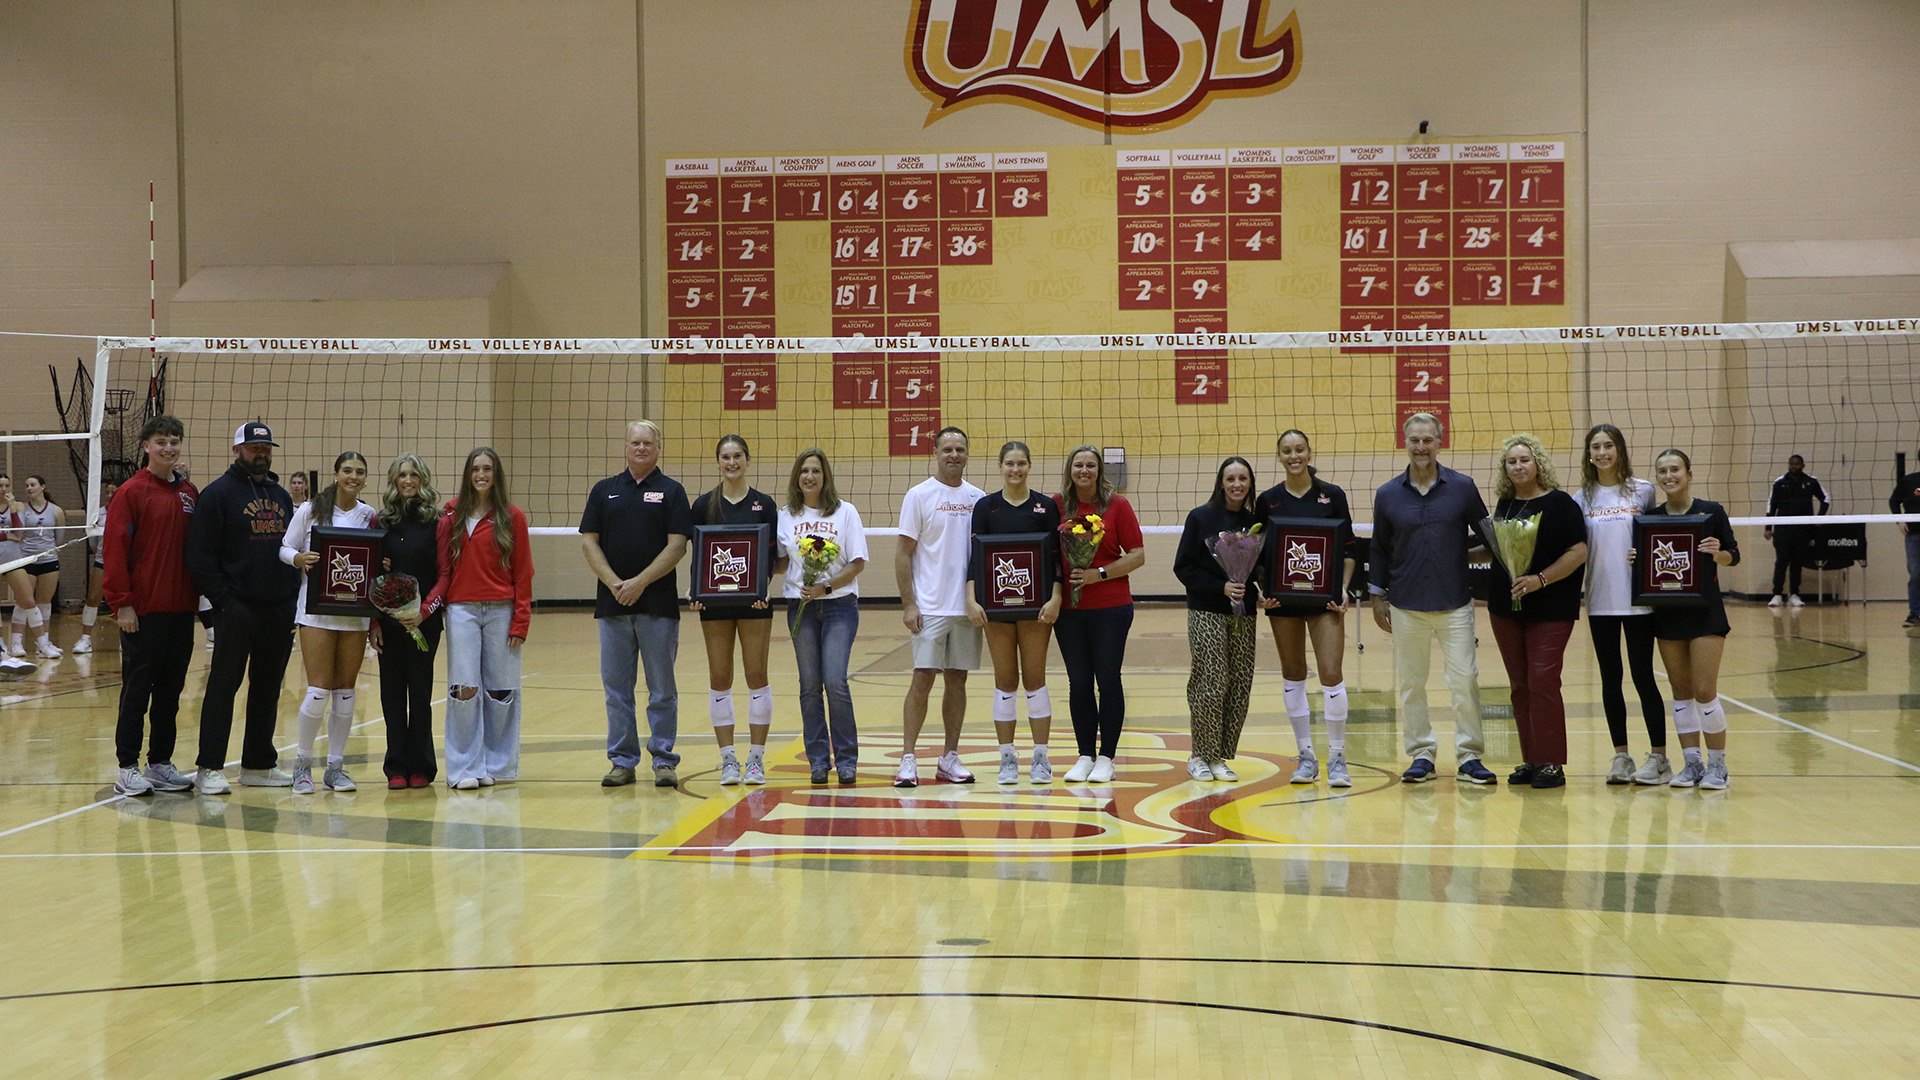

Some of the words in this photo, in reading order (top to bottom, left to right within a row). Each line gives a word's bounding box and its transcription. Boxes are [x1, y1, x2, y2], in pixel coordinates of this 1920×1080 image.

[976, 188, 985, 209] 1
[1012, 188, 1029, 208] 8
[1135, 185, 1150, 206] 5
[1191, 184, 1206, 204] 6
[1246, 183, 1262, 204] 3
[1350, 180, 1361, 201] 1
[1373, 180, 1389, 201] 2
[1417, 180, 1428, 200] 1
[1488, 179, 1504, 200] 7
[1520, 178, 1530, 199] 1
[684, 193, 699, 213] 2
[742, 192, 752, 212] 1
[812, 191, 822, 211] 1
[838, 190, 853, 210] 6
[863, 190, 878, 210] 4
[902, 189, 918, 210] 6
[900, 236, 924, 257] 17
[950, 236, 978, 256] 36
[1132, 232, 1155, 253] 10
[1194, 232, 1204, 252] 1
[1246, 231, 1261, 251] 4
[1344, 229, 1364, 249] 16
[1377, 228, 1387, 249] 1
[1417, 227, 1428, 248] 1
[1464, 227, 1491, 248] 25
[1528, 226, 1544, 247] 4
[680, 240, 703, 261] 14
[740, 239, 755, 260] 2
[835, 238, 854, 258] 16
[864, 237, 880, 257] 4
[867, 284, 877, 305] 1
[907, 284, 916, 304] 1
[1136, 280, 1151, 300] 2
[1192, 279, 1208, 300] 9
[1360, 276, 1375, 297] 7
[1414, 276, 1430, 296] 6
[1487, 276, 1502, 296] 3
[1531, 275, 1542, 295] 1
[686, 287, 701, 308] 5
[742, 286, 756, 307] 7
[835, 285, 854, 306] 15
[1328, 332, 1372, 342] UMSL
[1384, 331, 1487, 341] VOLLEYBALL
[1560, 328, 1605, 339] UMSL
[1616, 326, 1721, 337] VOLLEYBALL
[1796, 322, 1842, 333] UMSL
[204, 339, 248, 350] UMSL
[259, 339, 359, 350] VOLLEYBALL
[428, 340, 471, 350] UMSL
[482, 340, 582, 351] VOLLEYBALL
[651, 340, 694, 350] UMSL
[705, 339, 805, 350] VOLLEYBALL
[875, 338, 918, 348] UMSL
[929, 337, 1030, 348] VOLLEYBALL
[1100, 336, 1144, 347] UMSL
[1156, 335, 1257, 346] VOLLEYBALL
[741, 380, 756, 401] 2
[870, 379, 879, 400] 1
[906, 379, 921, 399] 5
[1192, 374, 1208, 395] 2
[1414, 371, 1430, 392] 2
[910, 425, 918, 446] 1
[251, 520, 286, 533] UMSL
[794, 521, 838, 536] UMSL
[1828, 538, 1858, 546] molten
[717, 564, 745, 574] UMSL
[1291, 560, 1318, 571] UMSL
[1658, 559, 1686, 570] UMSL
[335, 572, 362, 582] UMSL
[1001, 575, 1028, 587] UMSL
